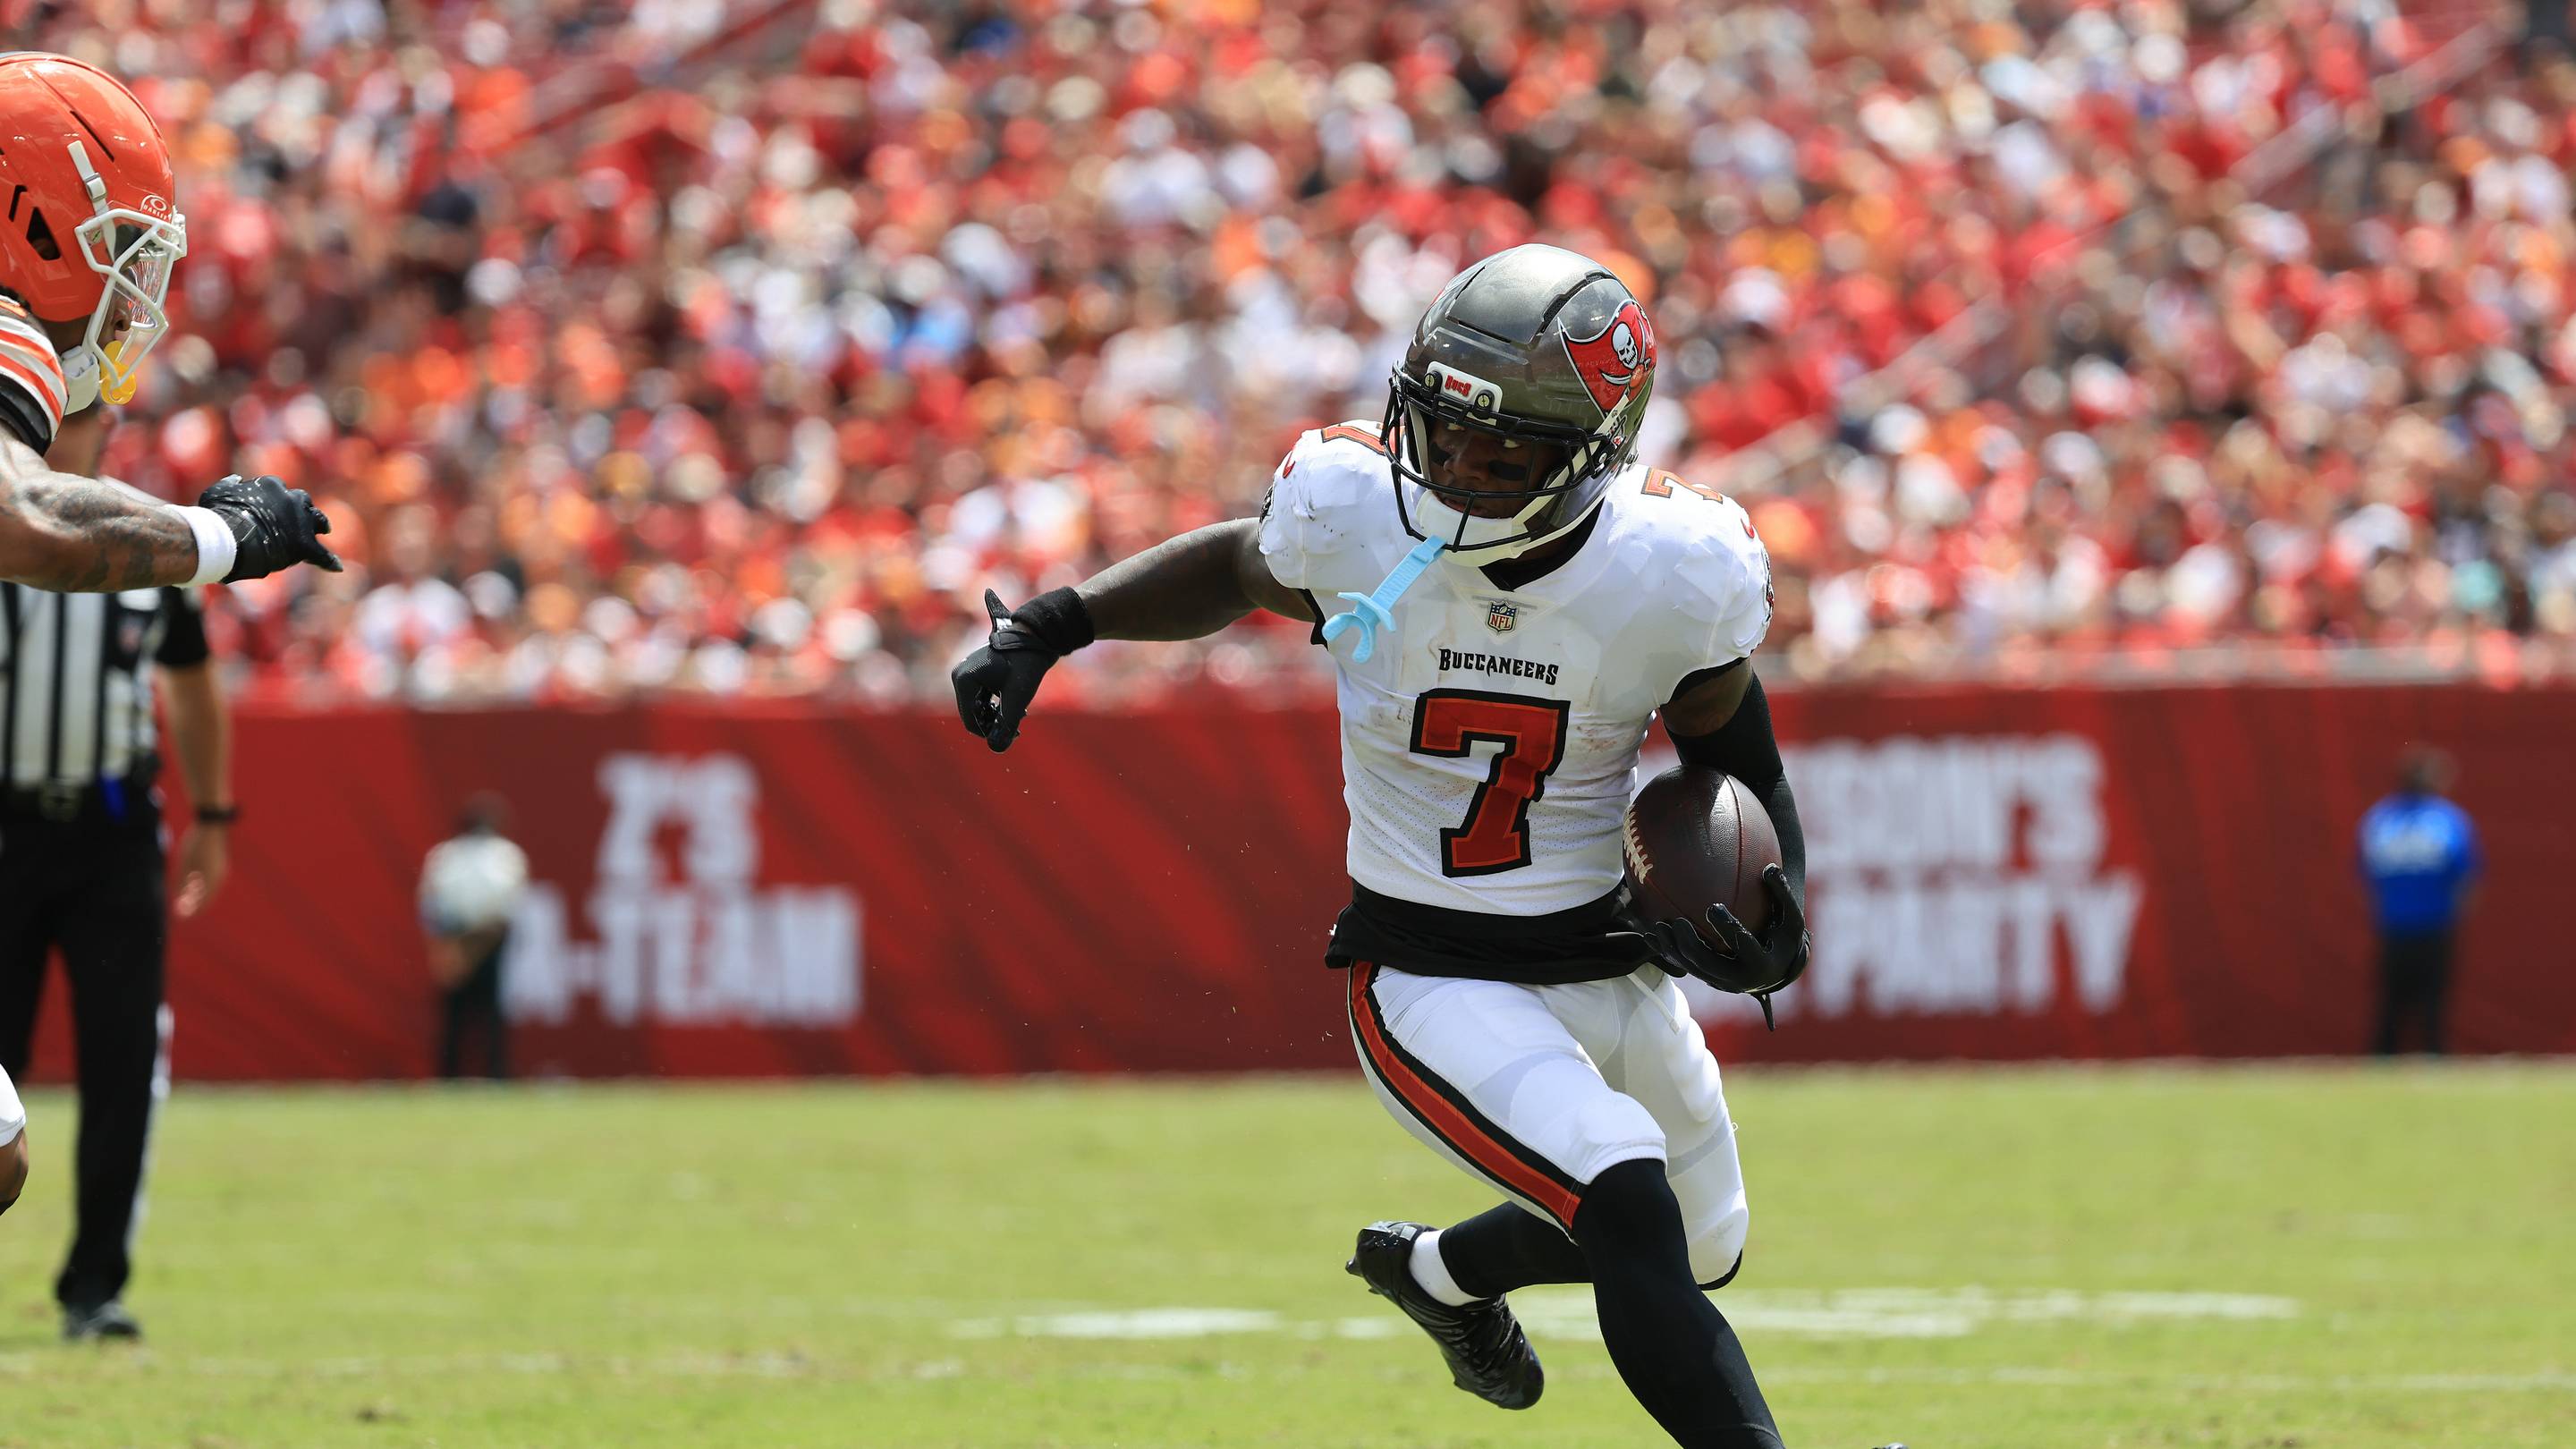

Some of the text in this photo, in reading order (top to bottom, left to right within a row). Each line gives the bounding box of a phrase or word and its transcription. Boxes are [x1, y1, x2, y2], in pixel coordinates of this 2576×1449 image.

[1489, 614, 1511, 629] NFL
[1438, 648, 1559, 686] BUCCANEERS
[1409, 687, 1571, 877] 7
[1810, 874, 2139, 1012] PARTY
